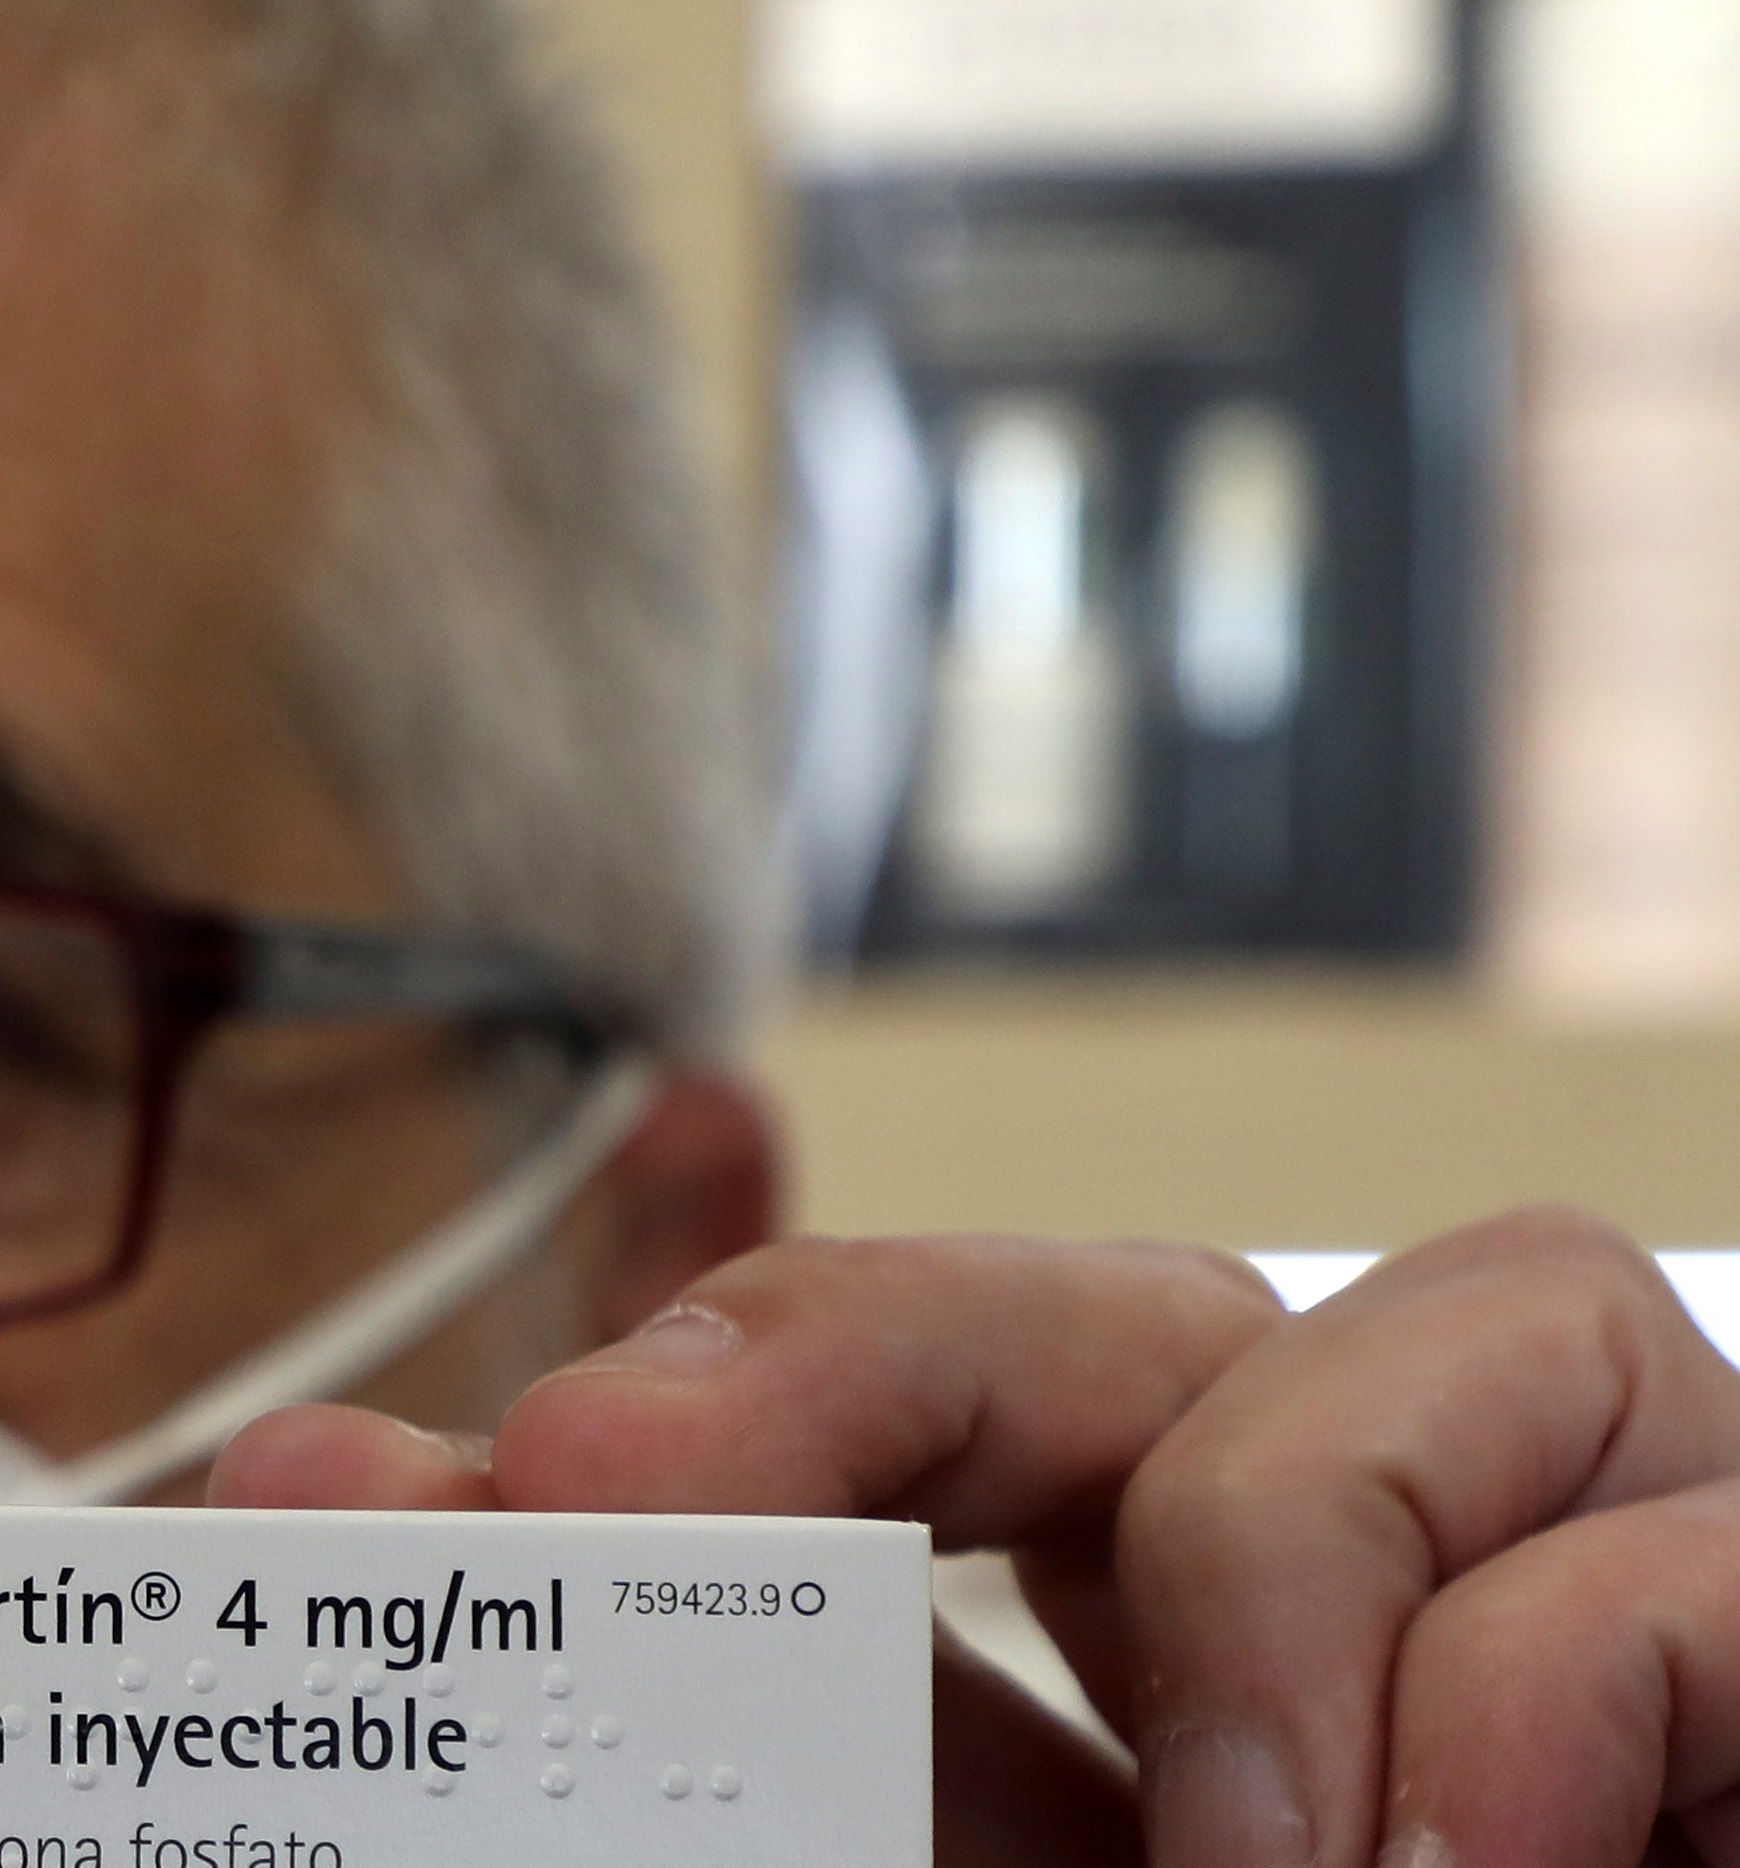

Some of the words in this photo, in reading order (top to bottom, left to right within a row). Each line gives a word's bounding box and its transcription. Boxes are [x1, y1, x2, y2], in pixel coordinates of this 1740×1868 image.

[216, 1579, 268, 1647] 4
[307, 1570, 563, 1671] mg/ml
[612, 1581, 781, 1617] 759423.9
[49, 1691, 467, 1788] inyectable
